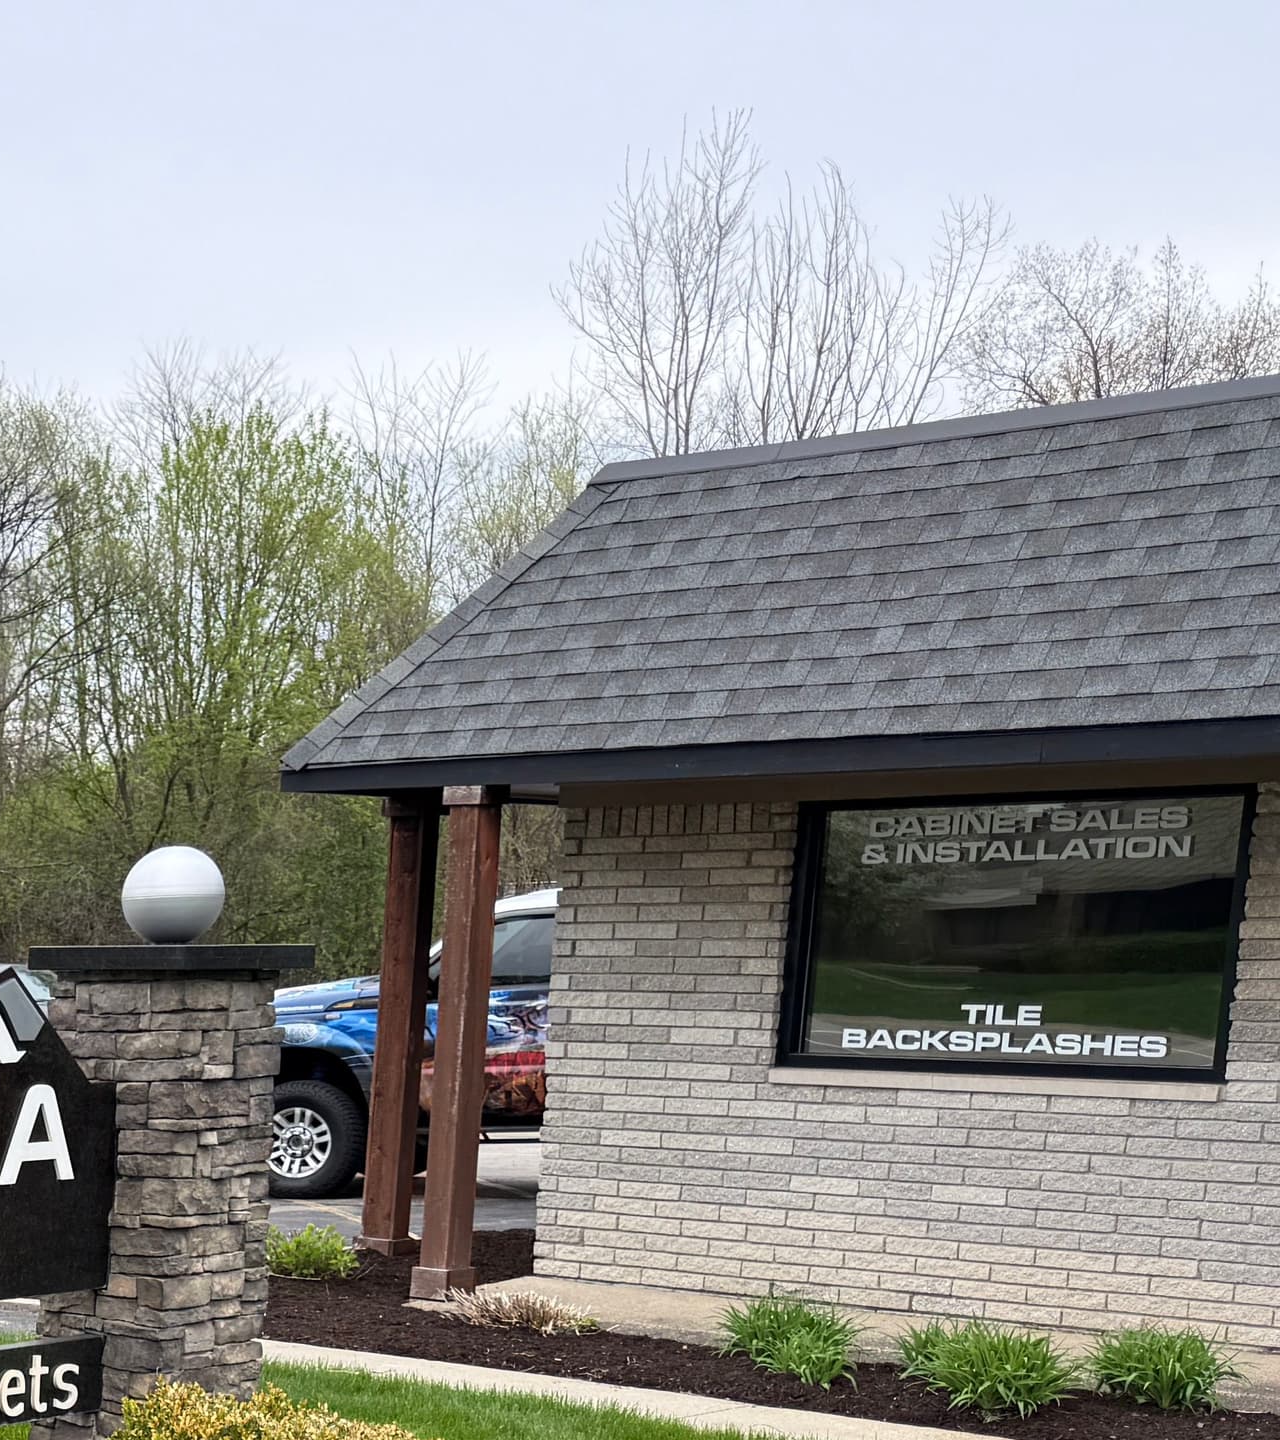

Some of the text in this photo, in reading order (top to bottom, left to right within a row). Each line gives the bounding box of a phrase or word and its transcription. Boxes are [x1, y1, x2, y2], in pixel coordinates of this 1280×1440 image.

[870, 806, 1189, 838] CABINET SALES
[861, 836, 1192, 865] & INSTALLATION
[961, 1004, 1043, 1027] TILE
[842, 1028, 1168, 1058] BACKSPLASHES
